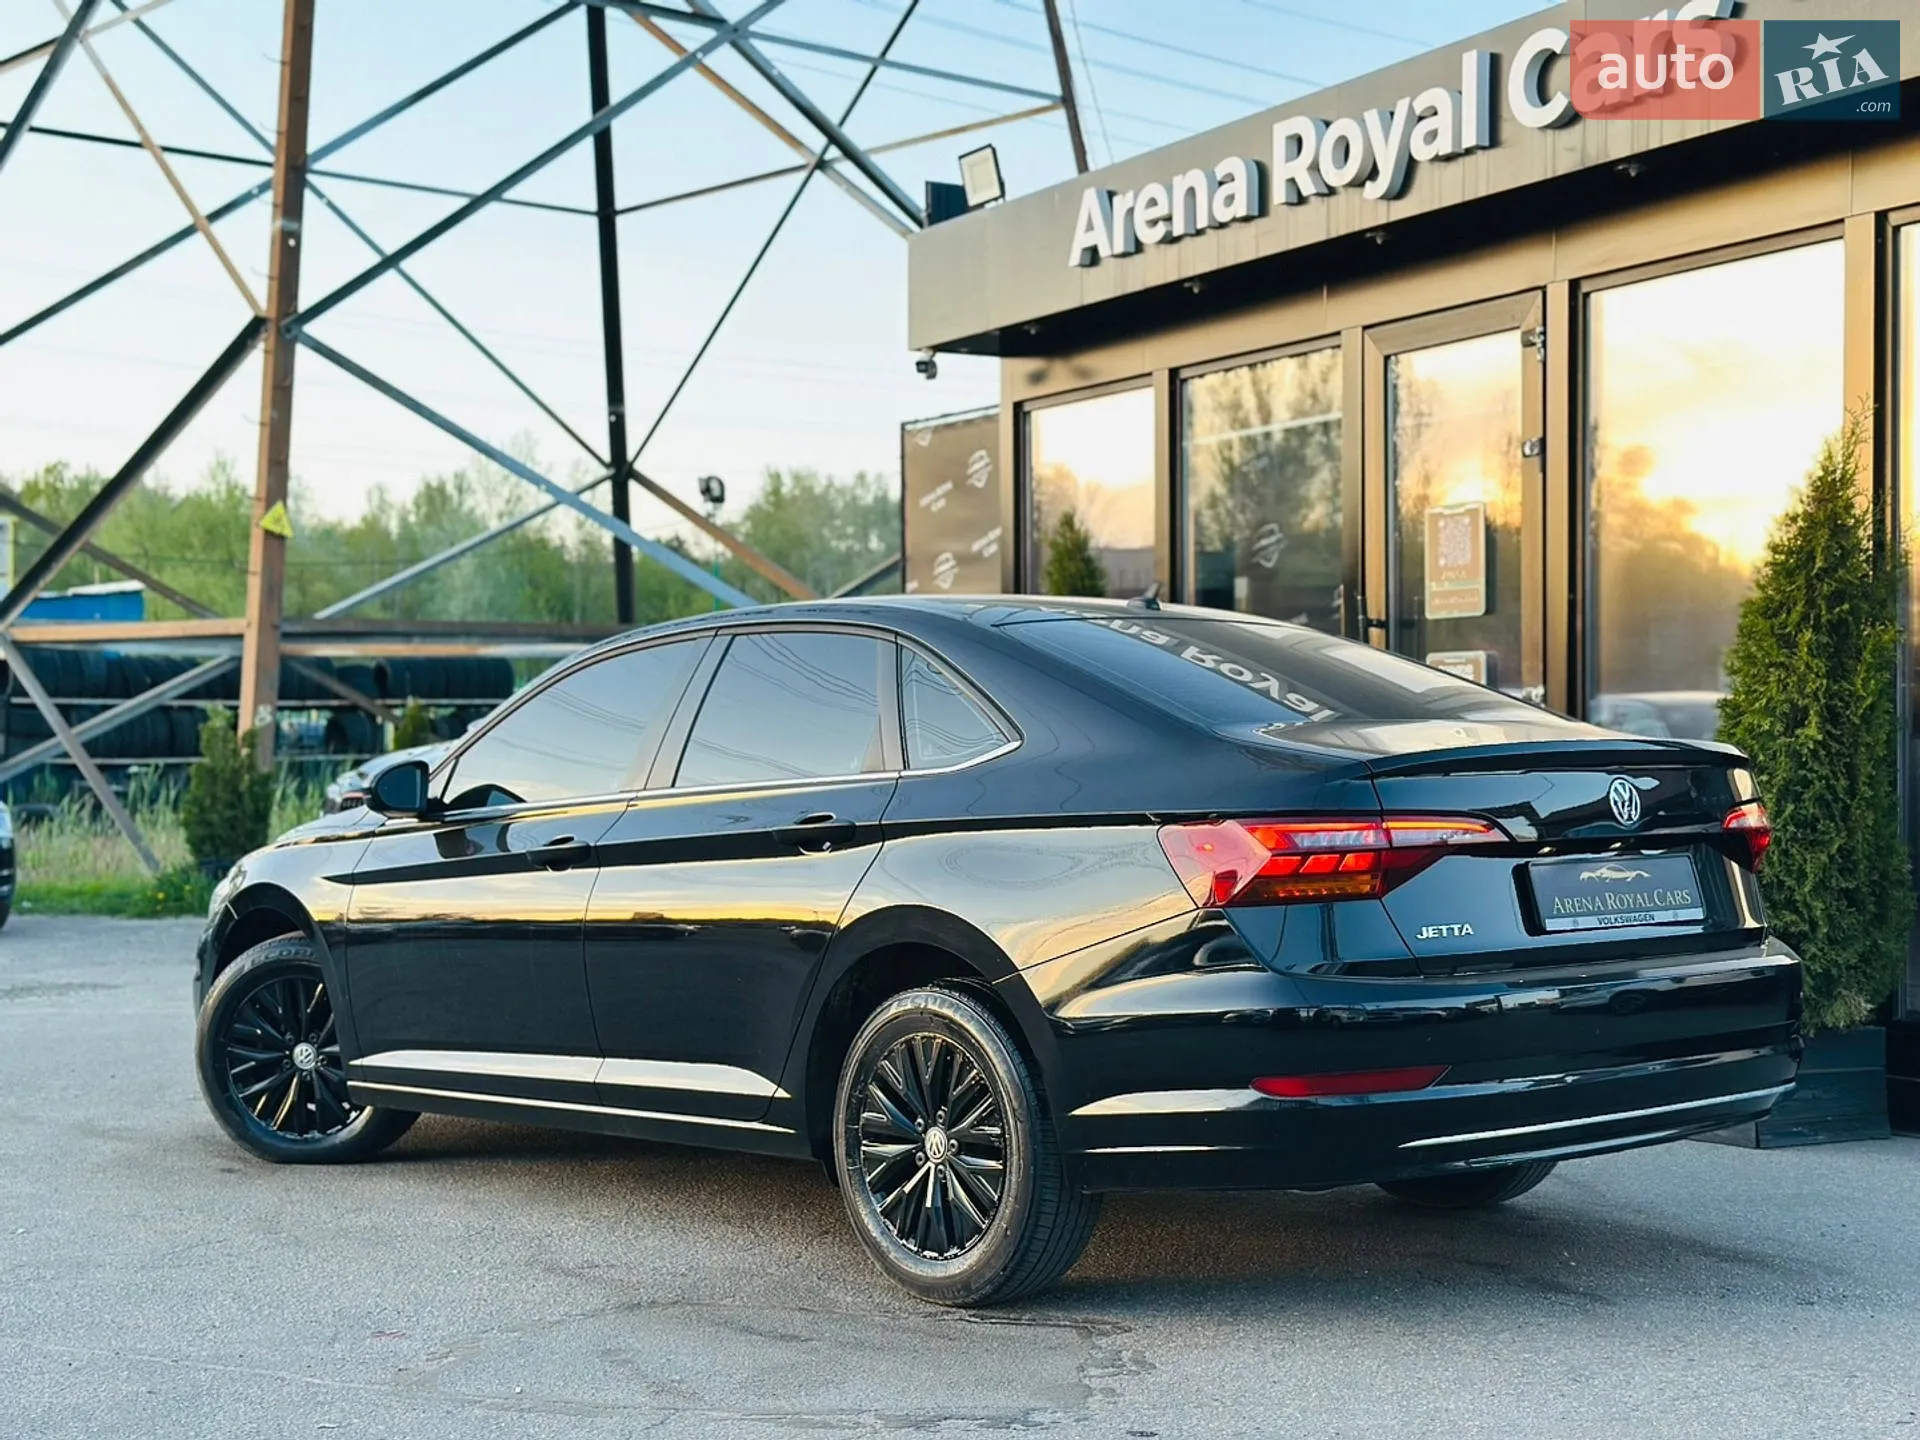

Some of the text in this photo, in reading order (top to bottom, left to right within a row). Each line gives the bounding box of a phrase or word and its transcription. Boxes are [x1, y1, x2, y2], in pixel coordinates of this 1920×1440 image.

[1069, 0, 1730, 267] Arena Royal Cars
[1553, 888, 1692, 914] ARENA ROYAL CARS
[1597, 913, 1655, 926] VOLKSWAGEN
[1416, 923, 1474, 940] JETTA
